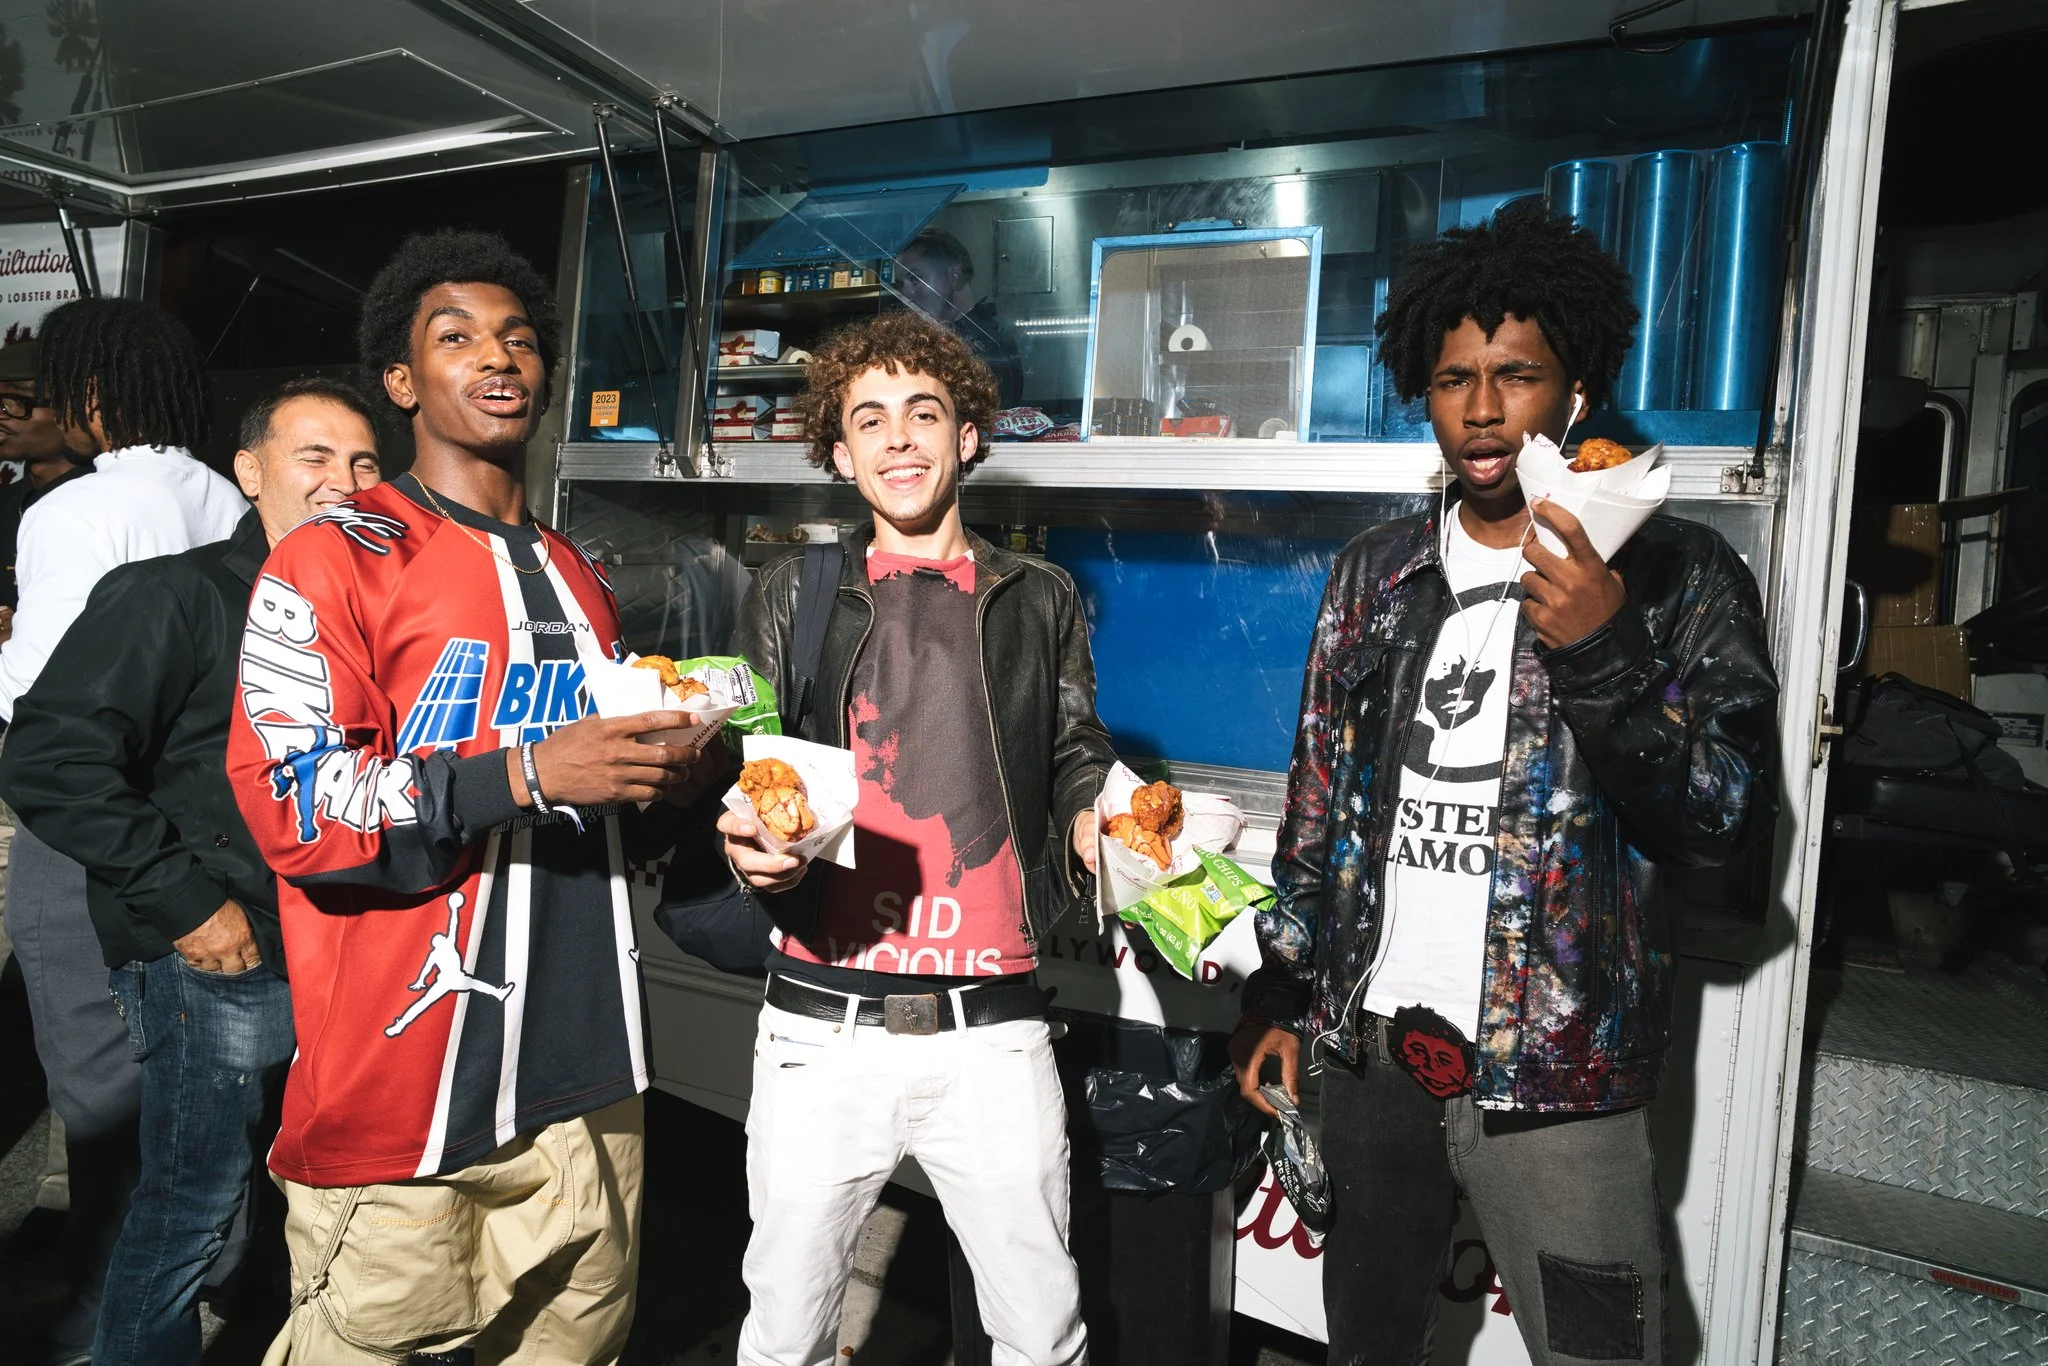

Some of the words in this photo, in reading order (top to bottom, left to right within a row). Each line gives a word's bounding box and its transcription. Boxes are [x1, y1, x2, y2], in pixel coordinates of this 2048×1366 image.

[8, 290, 51, 303] LOBSTER
[56, 288, 79, 300] BRA
[595, 394, 617, 404] 2023
[511, 620, 590, 634] JORDAN
[748, 686, 756, 702] Facts
[311, 748, 420, 832] AIR
[1213, 858, 1244, 888] CHIPS
[1387, 835, 1494, 876] AMO
[872, 890, 962, 940] SID
[828, 936, 1004, 977] VICIOUS
[1037, 934, 1239, 994] LYWOD,
[1274, 1159, 1299, 1207] PEPPER
